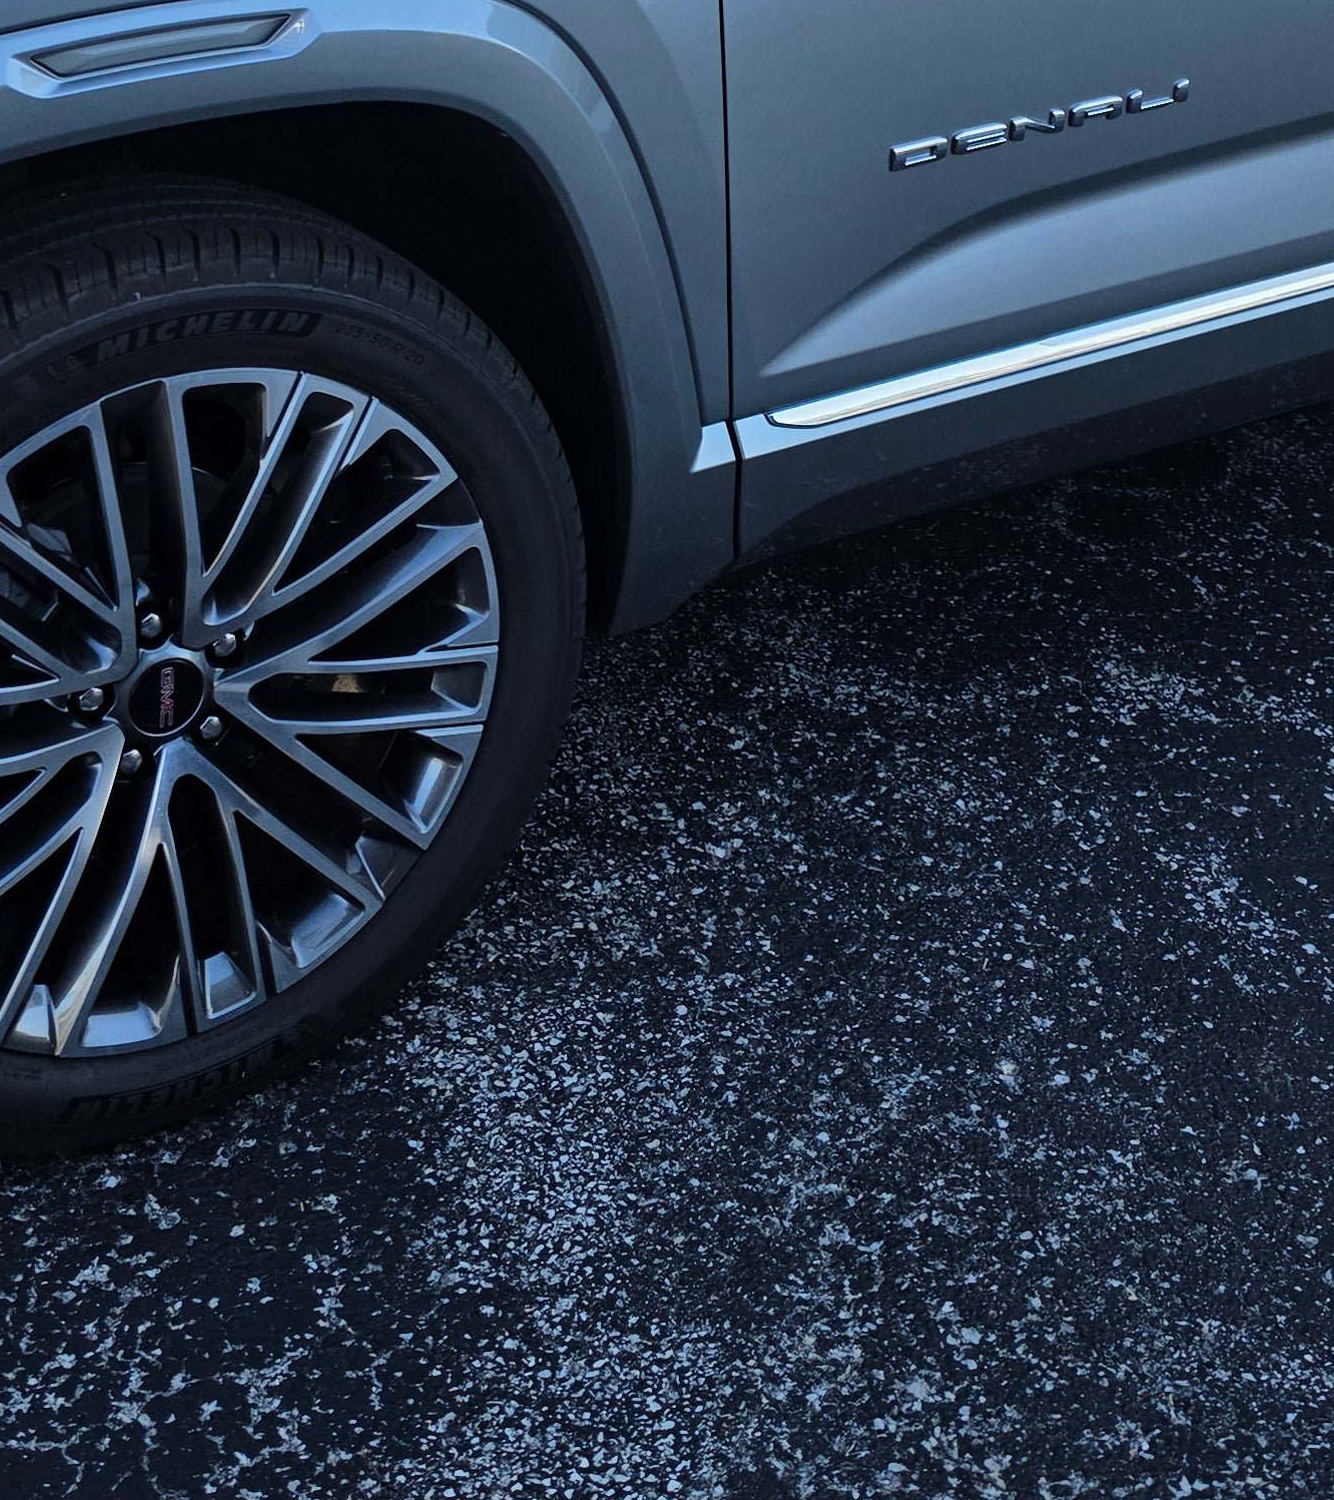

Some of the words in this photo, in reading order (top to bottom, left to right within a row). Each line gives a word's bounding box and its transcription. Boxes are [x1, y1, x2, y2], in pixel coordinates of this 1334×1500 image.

[888, 77, 1191, 172] DENALI
[95, 309, 310, 362] MICHELIN
[159, 666, 175, 729] GMC
